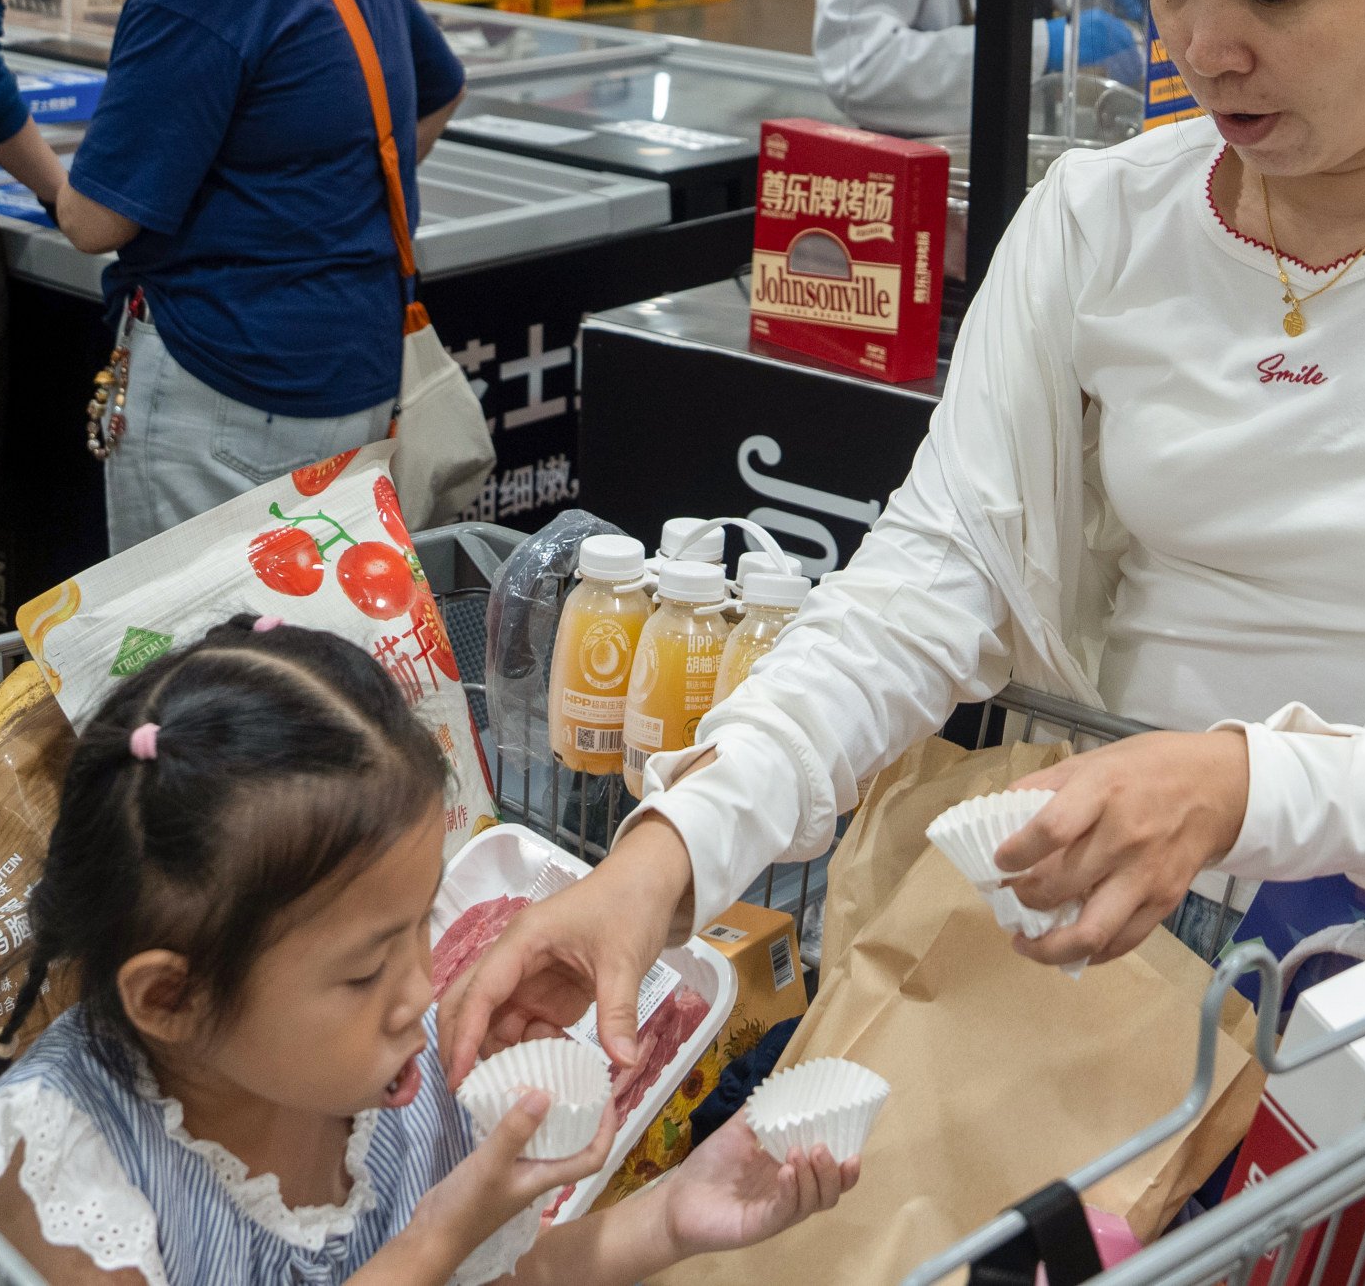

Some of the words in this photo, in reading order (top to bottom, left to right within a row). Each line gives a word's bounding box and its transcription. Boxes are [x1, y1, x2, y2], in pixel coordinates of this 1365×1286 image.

[760, 169, 894, 222] 尊乐牌烤肠
[755, 263, 891, 319] Johnsonville
[1256, 353, 1329, 385] Smile
[687, 634, 713, 654] HPP
[564, 691, 592, 707] HPP
[592, 699, 627, 710] 超高压冷
